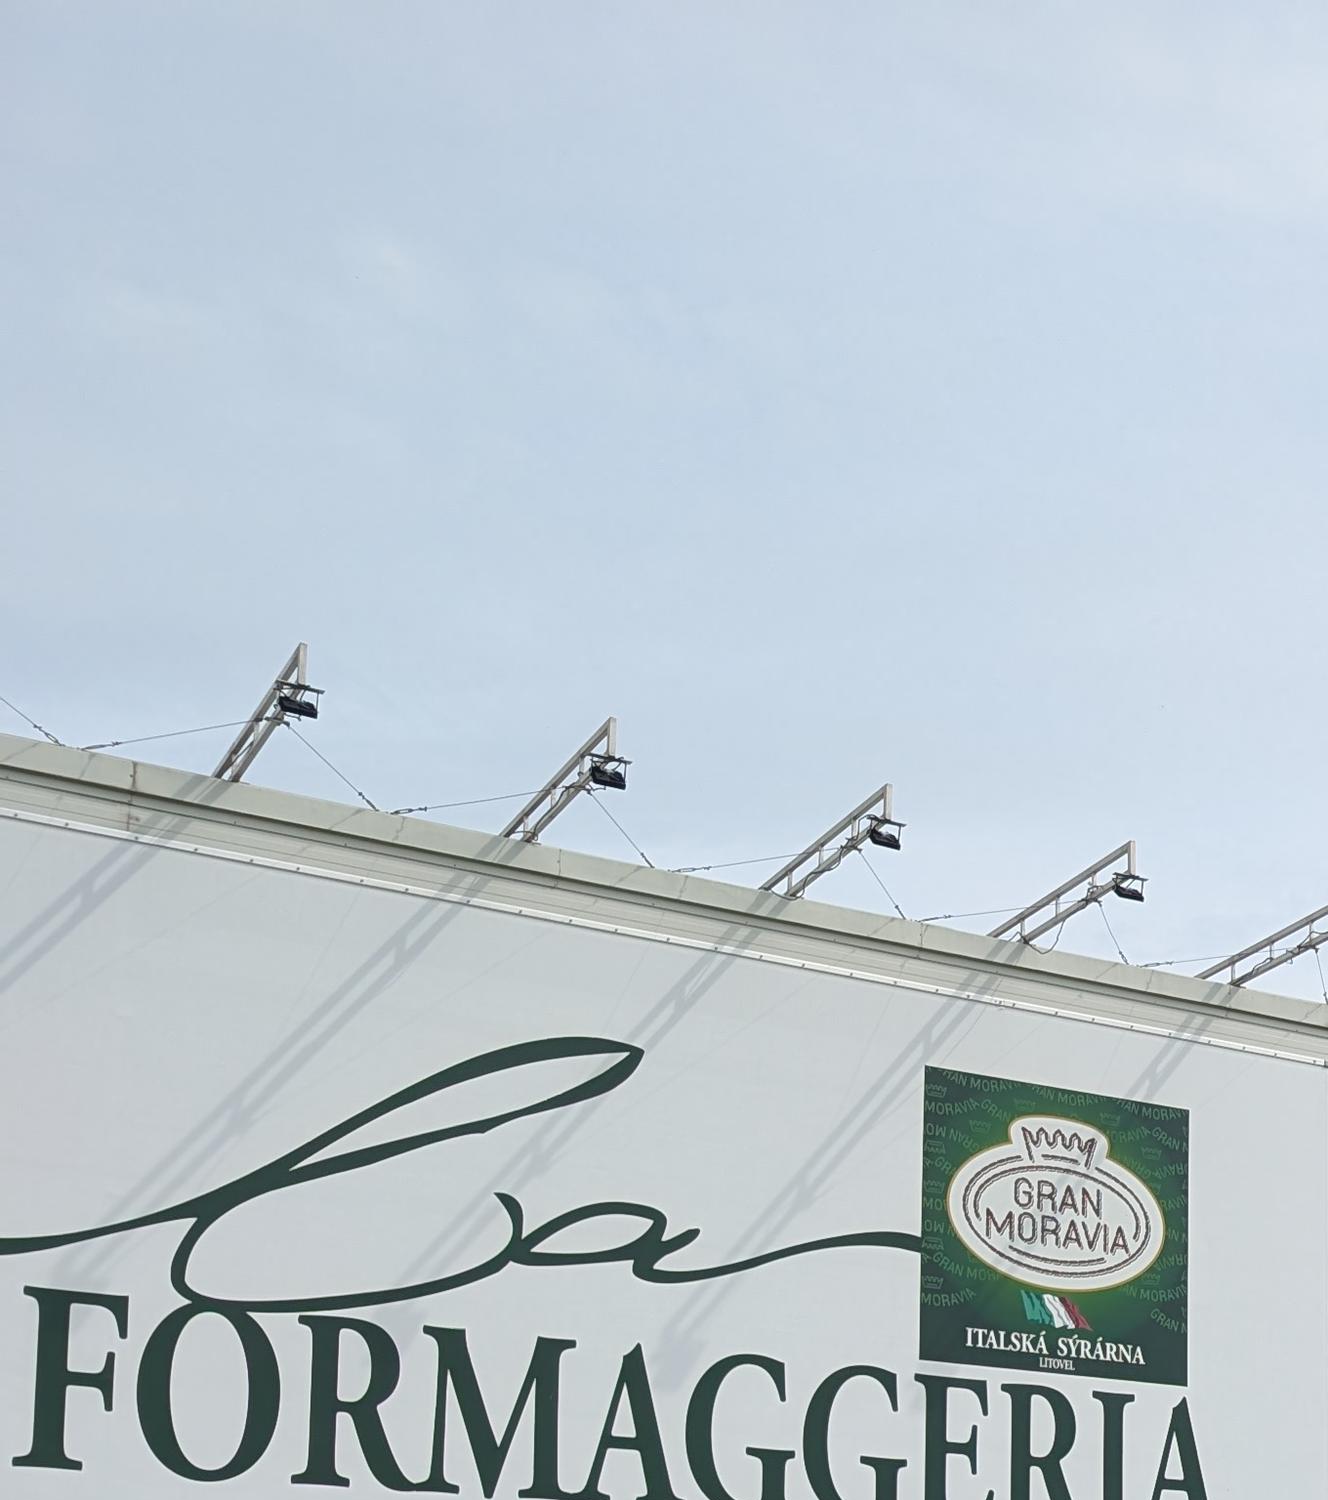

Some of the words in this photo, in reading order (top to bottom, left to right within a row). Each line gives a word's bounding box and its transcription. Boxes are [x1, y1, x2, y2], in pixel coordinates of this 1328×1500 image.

[925, 1097, 980, 1116] MORAVIA
[981, 1099, 1011, 1122] GRAN
[1108, 1125, 1151, 1144] ORAVIA
[1014, 1177, 1103, 1219] GRAN
[985, 1207, 1131, 1256] MORAVIA
[922, 1287, 977, 1307] MORAVIA
[1150, 1308, 1180, 1332] GRAN
[965, 1326, 1049, 1355] ITALSKÁ
[1057, 1334, 1146, 1365] SÝRÁRNA
[1039, 1357, 1076, 1371] LITOVEL
